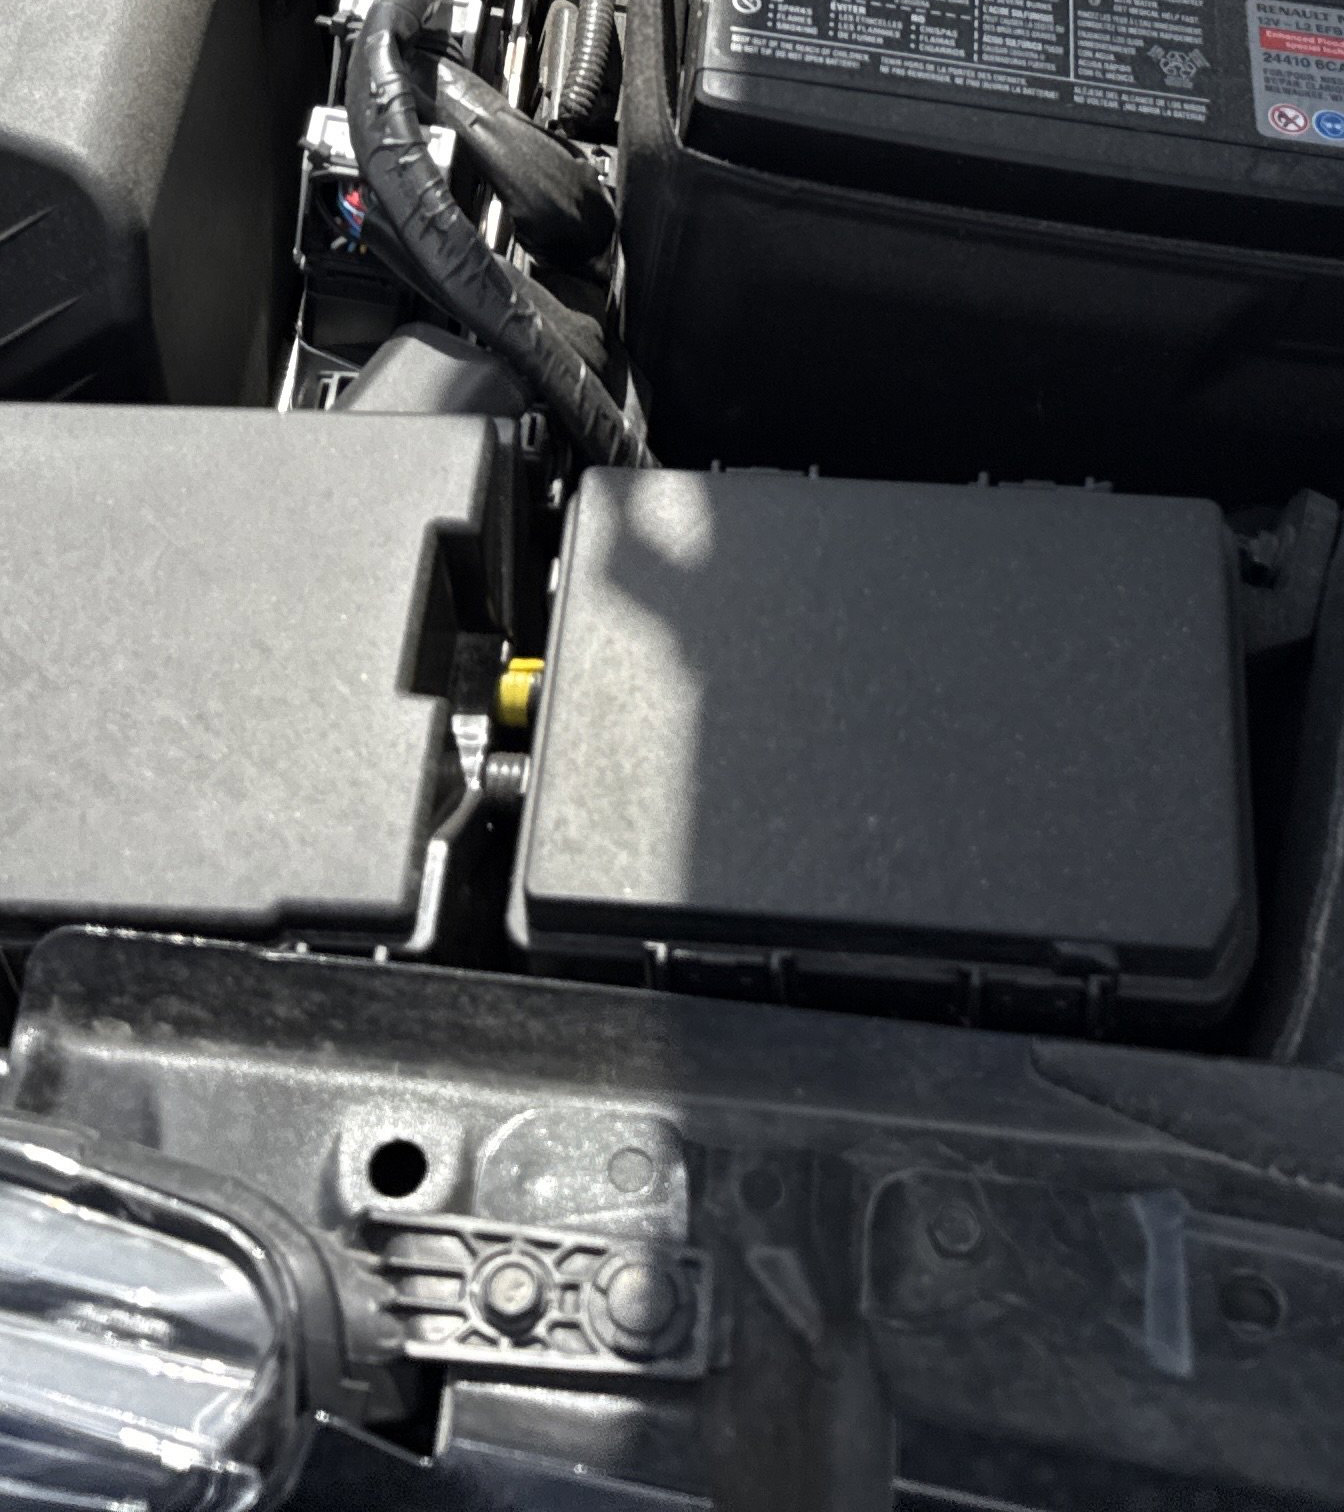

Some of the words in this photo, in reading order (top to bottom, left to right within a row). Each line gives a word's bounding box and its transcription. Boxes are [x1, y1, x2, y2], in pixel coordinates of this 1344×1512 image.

[1257, 3, 1329, 21] RENAULT
[1258, 16, 1280, 27] 12V
[1295, 21, 1312, 33] L2
[1315, 24, 1343, 36] EFB
[1265, 30, 1315, 42] Enhanced
[1263, 52, 1311, 69] 24410
